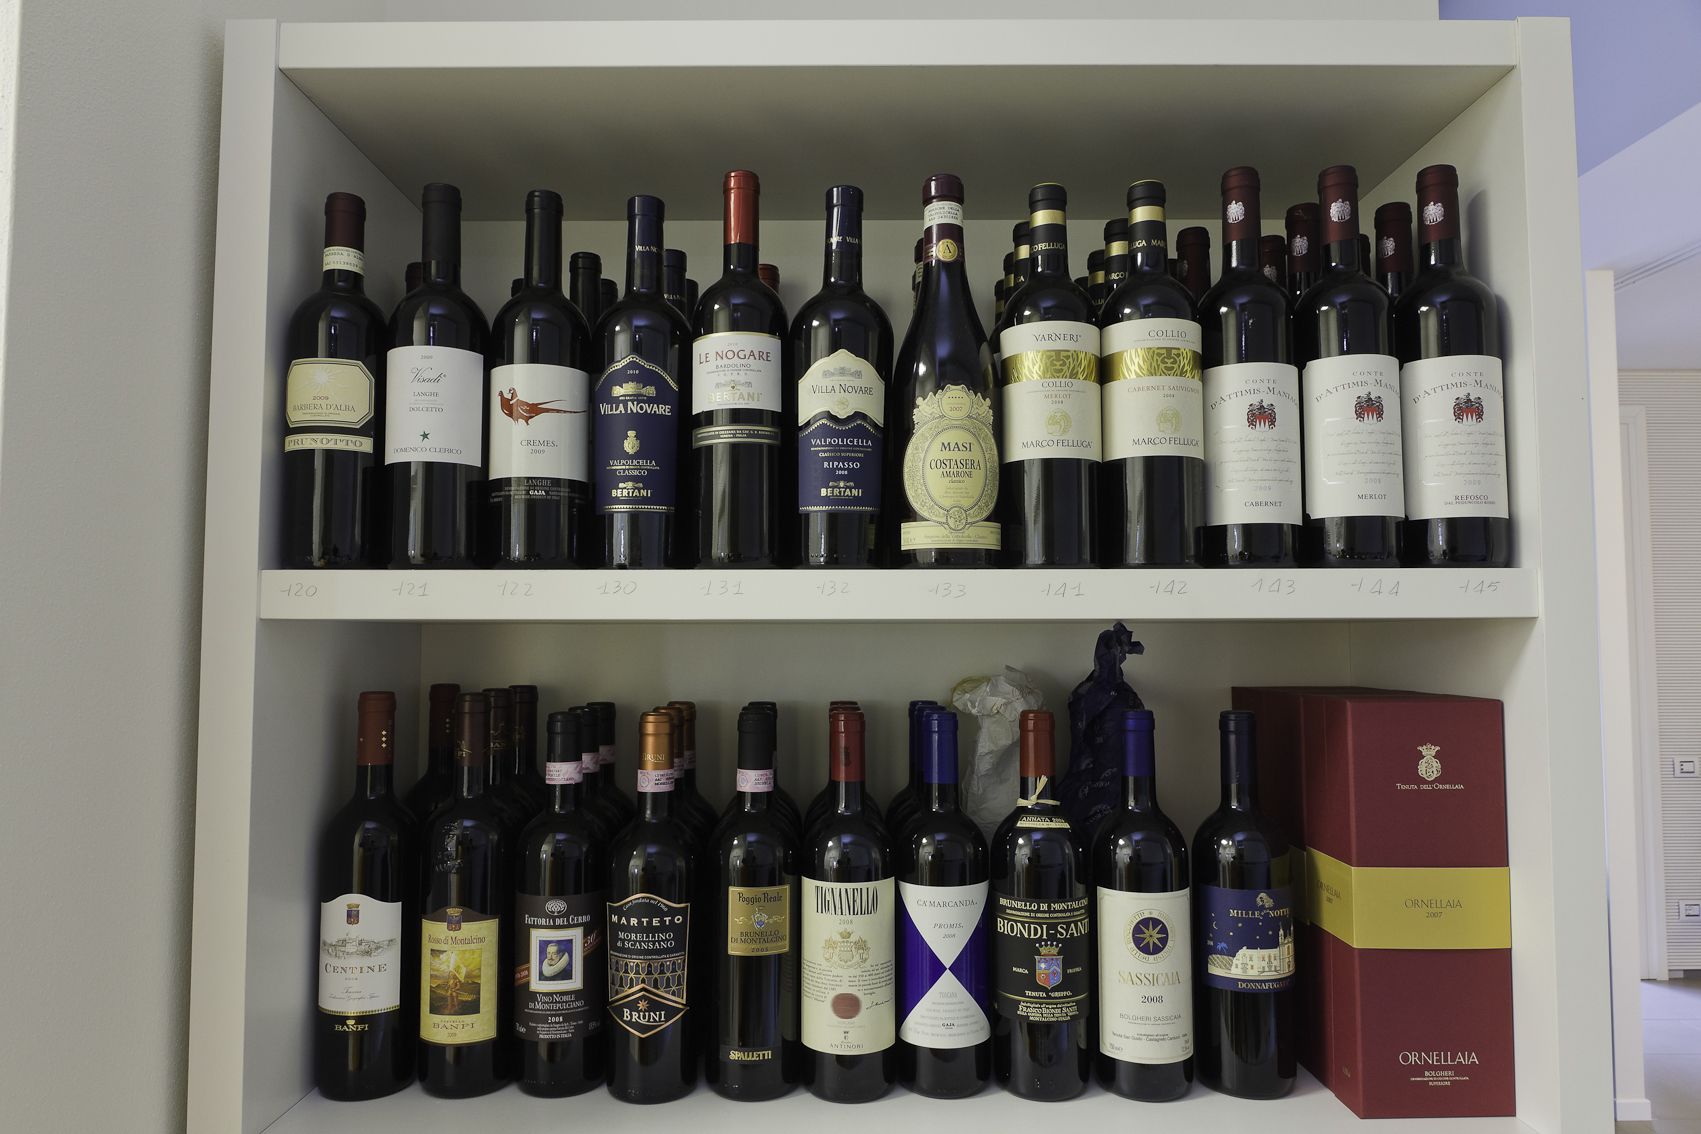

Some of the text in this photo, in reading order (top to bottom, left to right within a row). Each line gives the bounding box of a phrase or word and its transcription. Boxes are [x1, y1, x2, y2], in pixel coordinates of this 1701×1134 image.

[1148, 328, 1188, 338] COLLIO
[699, 349, 772, 365] LE NOGARE
[812, 383, 874, 396] VILLA NOVARE
[1041, 380, 1074, 389] COLLIO
[1127, 384, 1166, 392] CABERNET
[708, 391, 762, 404] BERTANI
[326, 403, 356, 412] D'ALBA
[600, 401, 673, 416] VILLA NOVARE
[288, 437, 364, 448] PRUNOTTO
[811, 437, 873, 446] VALPOLICELLA
[940, 441, 972, 452] MASI
[1021, 438, 1093, 449] MARCO FELLUGA
[1131, 436, 1167, 447] MARCO
[393, 446, 463, 455] DOMENICO CLERICO
[823, 461, 861, 469] RIPASSO
[929, 458, 982, 472] COSTASERA
[940, 470, 974, 479] AMARONE
[611, 489, 652, 497] BERTANI
[820, 488, 863, 497] BERTANI
[1454, 494, 1489, 502] REFOSCO
[1420, 782, 1465, 790] DELL'ORNELLAIA
[737, 890, 783, 906] Poggio Reale
[815, 885, 878, 916] TIGNANELLO
[999, 897, 1038, 910] BRUNELLO
[1404, 898, 1463, 909] ORNELLAIA
[1229, 909, 1260, 918] MILLE
[1426, 911, 1443, 919] 2007
[525, 913, 591, 926] FATTORIA DEL CERRO
[611, 914, 683, 927] MARTETO
[618, 931, 674, 941] MORELLINO
[740, 930, 780, 938] BRUNELLO
[450, 934, 487, 945] Montalcino
[739, 935, 787, 945] MONTALCINO
[624, 940, 675, 950] SCANSANO
[324, 963, 388, 975] CENTINE
[1118, 970, 1181, 986] SASSICAIA
[536, 993, 576, 1002] VINO NOBILE
[1024, 990, 1046, 998] TENUTA
[535, 999, 585, 1010] MONTEPULCIANO
[1141, 995, 1164, 1004] 2008
[1018, 1005, 1042, 1014] FRANCO
[1062, 1005, 1078, 1013] SANTI
[622, 1008, 665, 1023] BRUNI
[1119, 1012, 1182, 1022] BOLGHERI SASSICAIA
[334, 1023, 369, 1032] BANFI
[729, 1050, 773, 1061] SPALLETTI
[1398, 1051, 1480, 1065] ORNELLAIA
